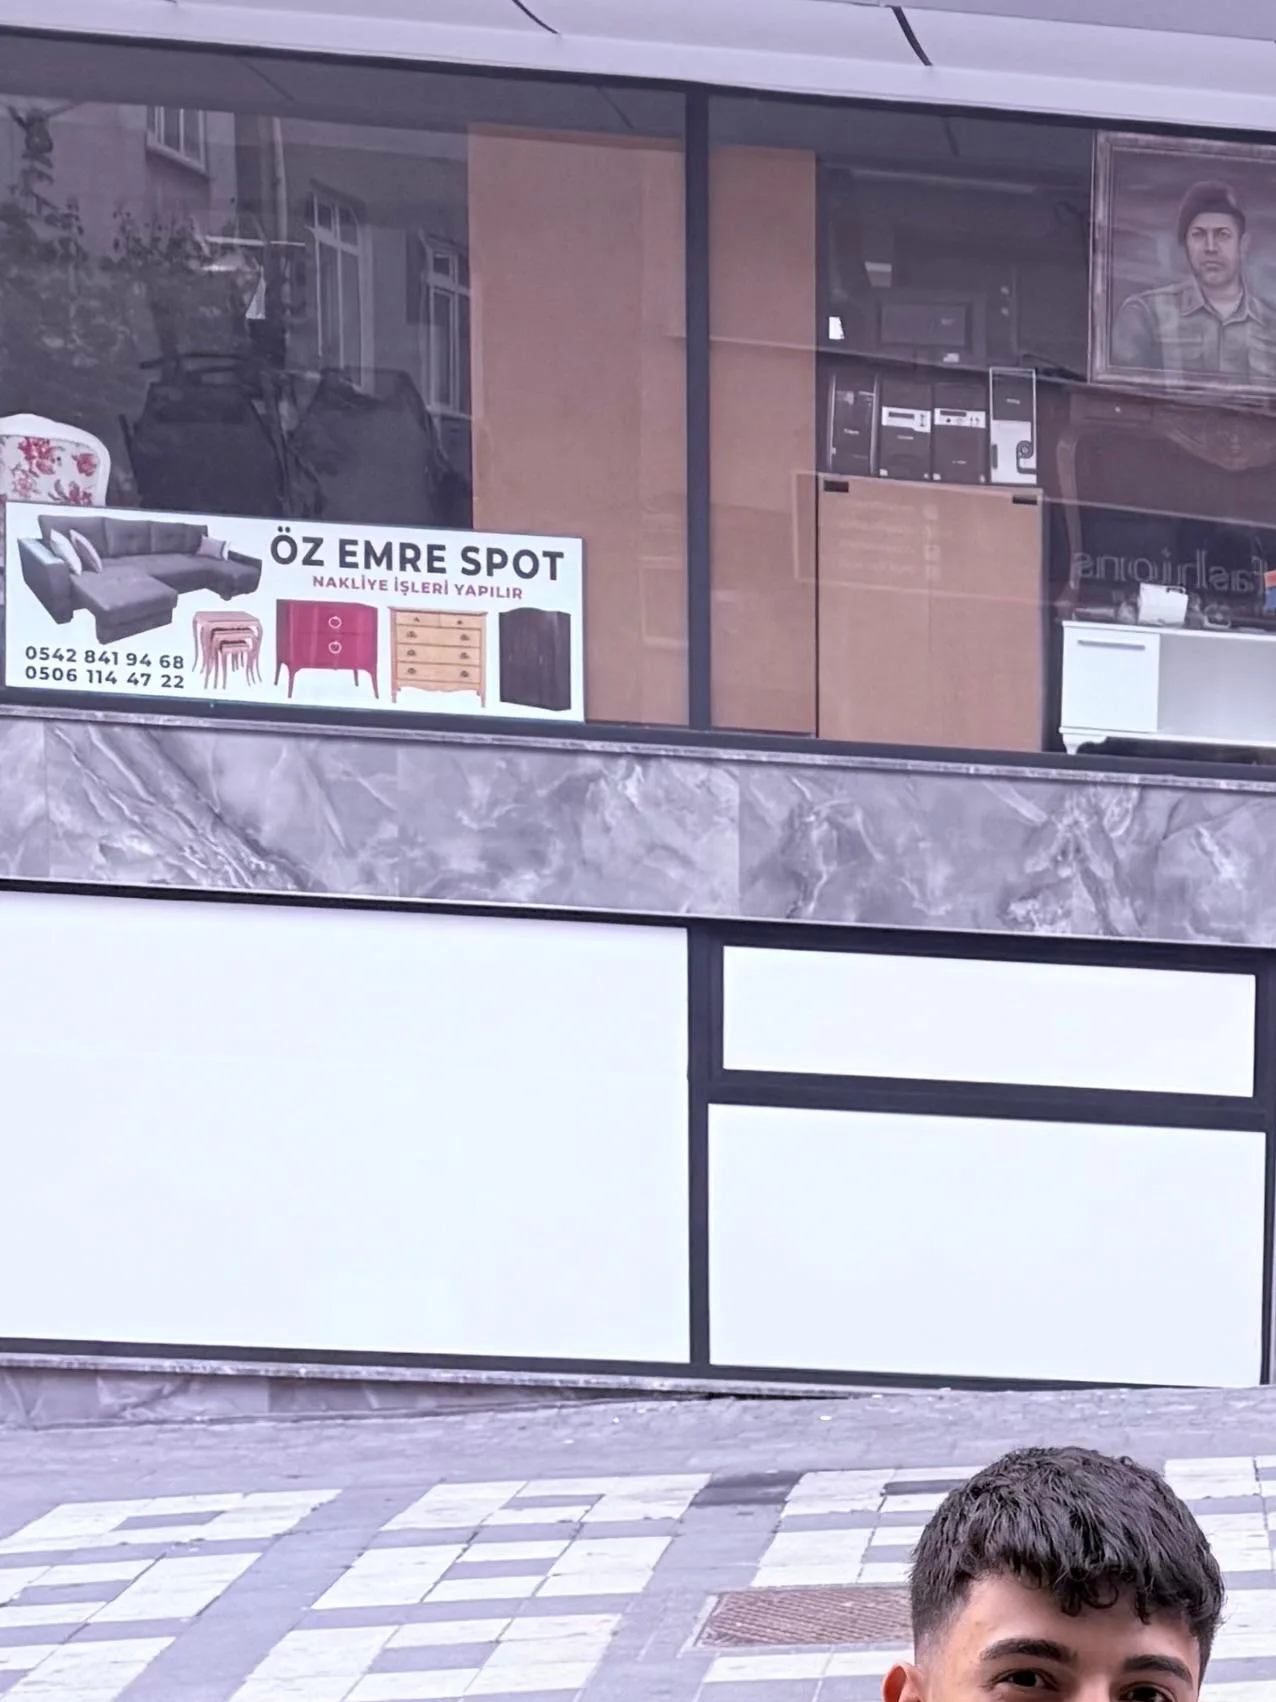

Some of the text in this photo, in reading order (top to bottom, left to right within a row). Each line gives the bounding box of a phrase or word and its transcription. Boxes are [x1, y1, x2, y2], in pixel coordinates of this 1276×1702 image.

[270, 525, 565, 581] ÖZ EMRE SPOT
[312, 574, 523, 600] NAKLİYE İŞLERİ YAPILIR
[25, 645, 184, 670] 0542 841 94 68
[25, 665, 185, 689] 0506 114 47 22
